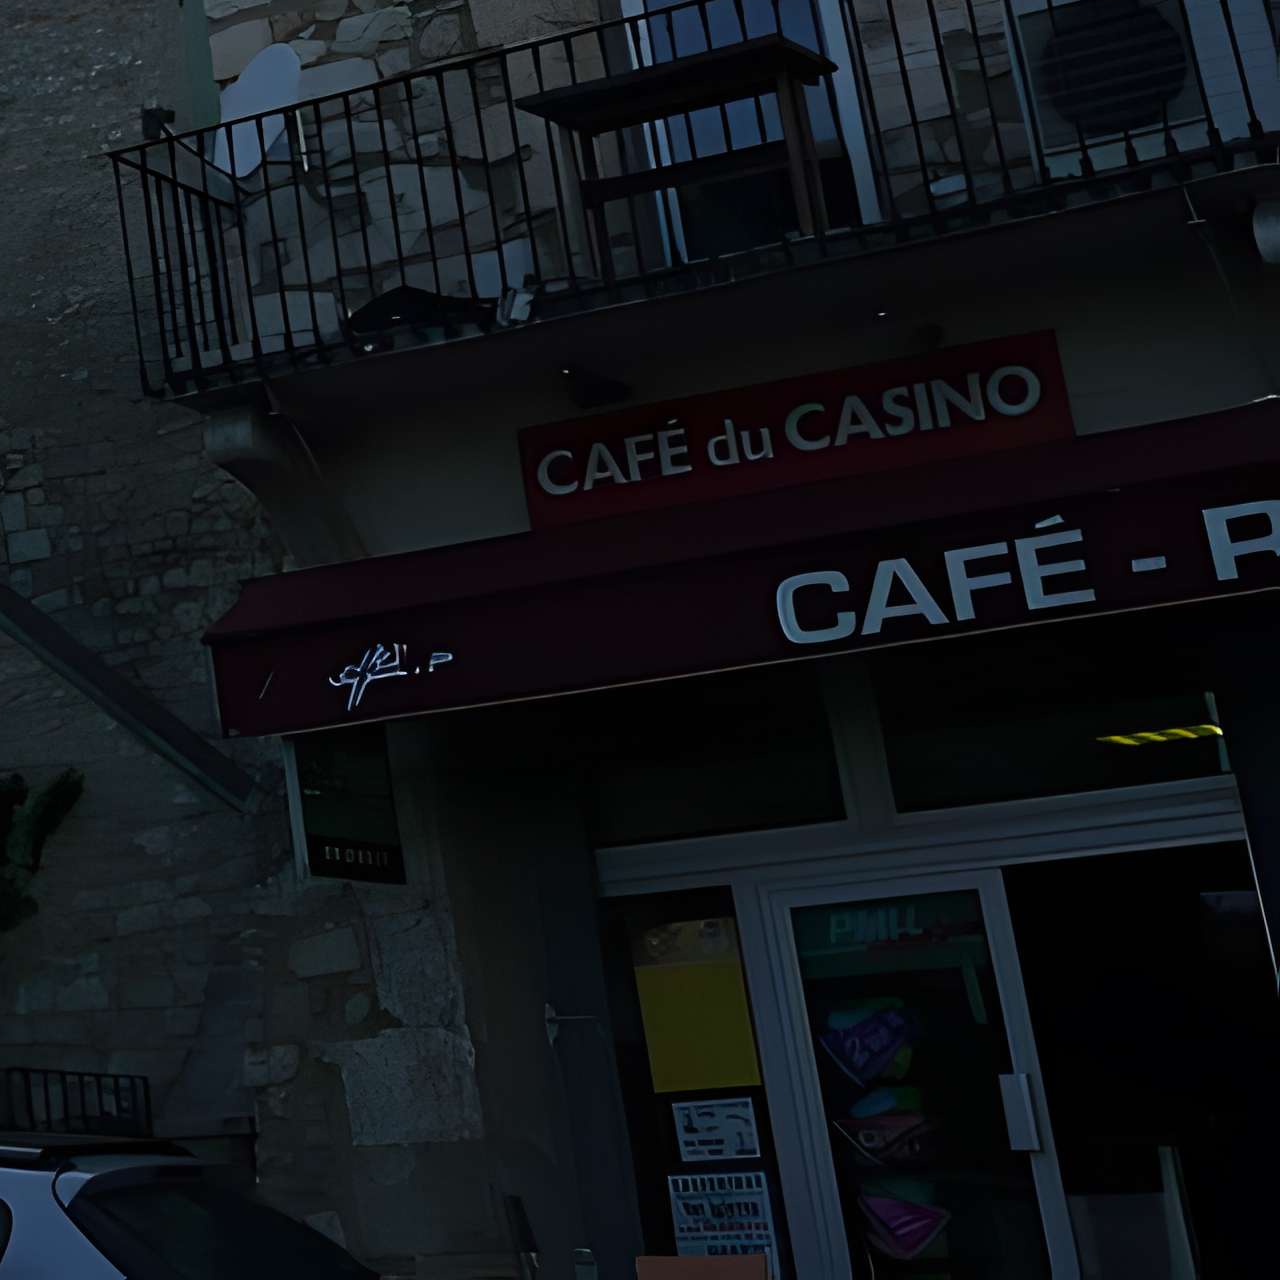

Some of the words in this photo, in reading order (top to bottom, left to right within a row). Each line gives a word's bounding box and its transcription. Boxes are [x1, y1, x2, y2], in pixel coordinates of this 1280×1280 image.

[537, 417, 693, 496] CAFÉ
[706, 417, 775, 467] du
[784, 364, 1042, 452] CASINO
[775, 514, 1097, 645] CAFÉ
